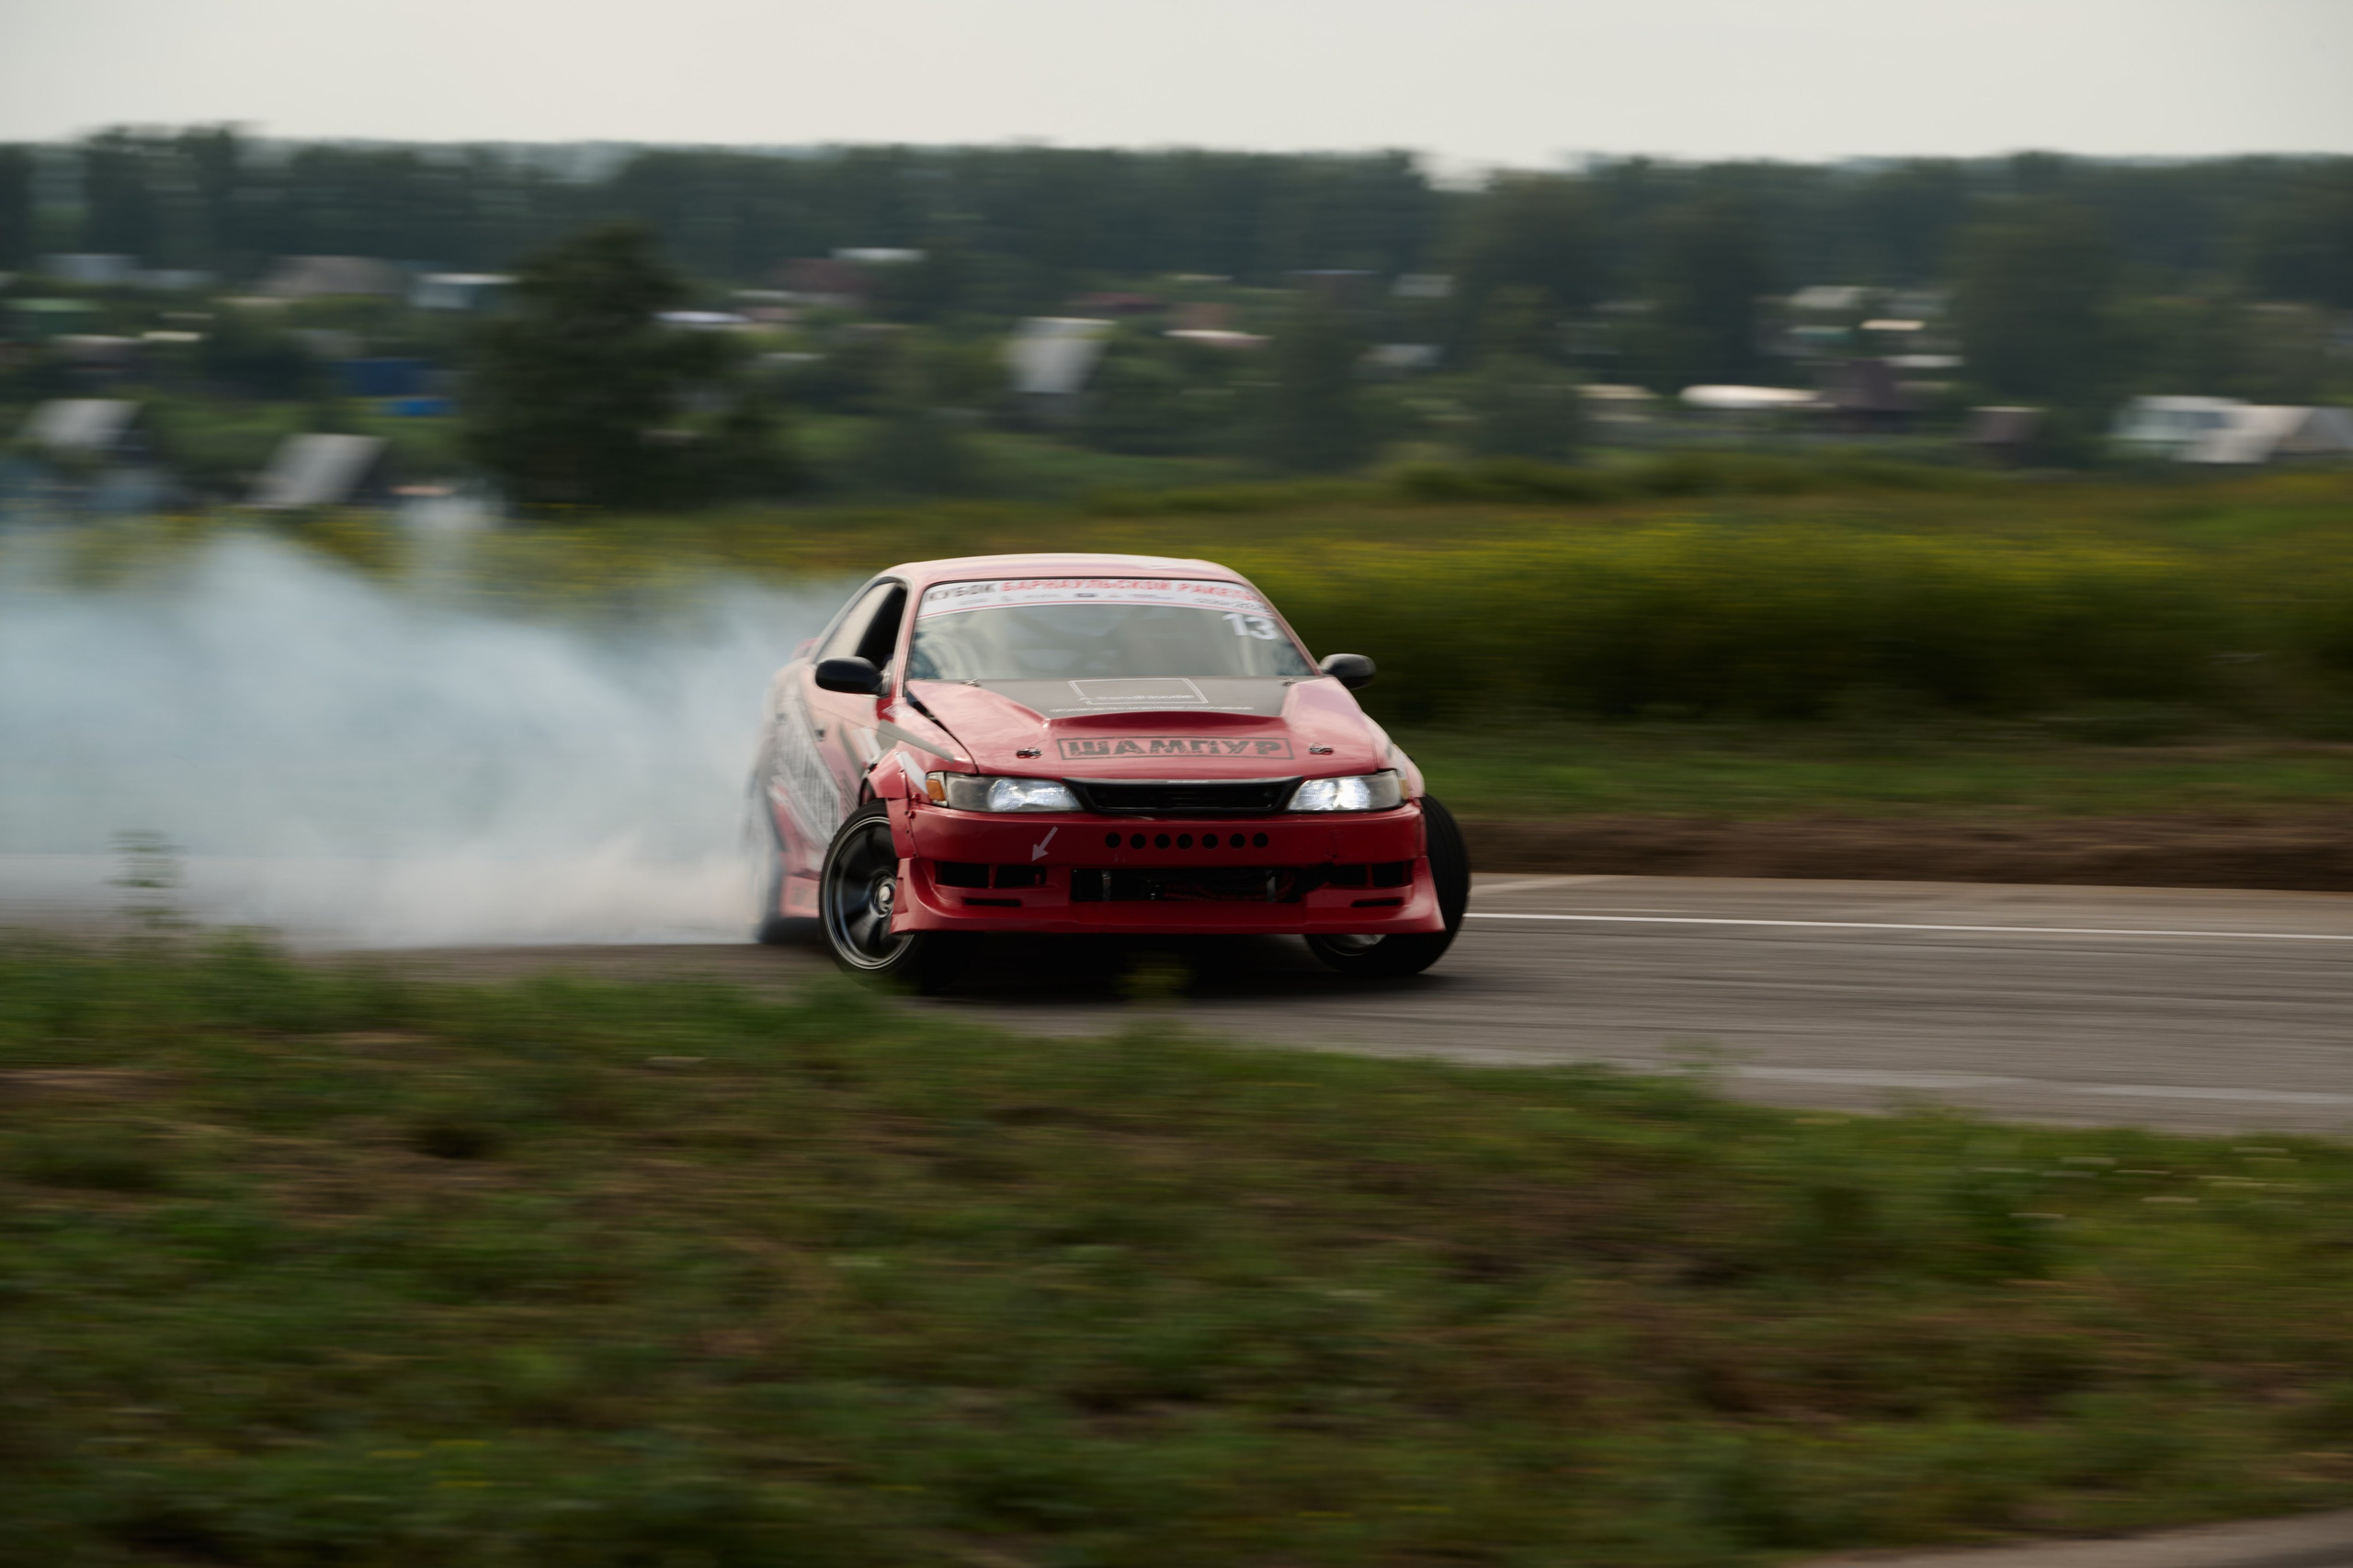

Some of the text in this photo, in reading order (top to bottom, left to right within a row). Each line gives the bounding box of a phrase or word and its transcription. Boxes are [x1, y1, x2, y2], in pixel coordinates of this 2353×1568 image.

[926, 583, 996, 602] КУБОК
[1222, 613, 1279, 641] 13
[1068, 739, 1281, 756] ШАМПУР
